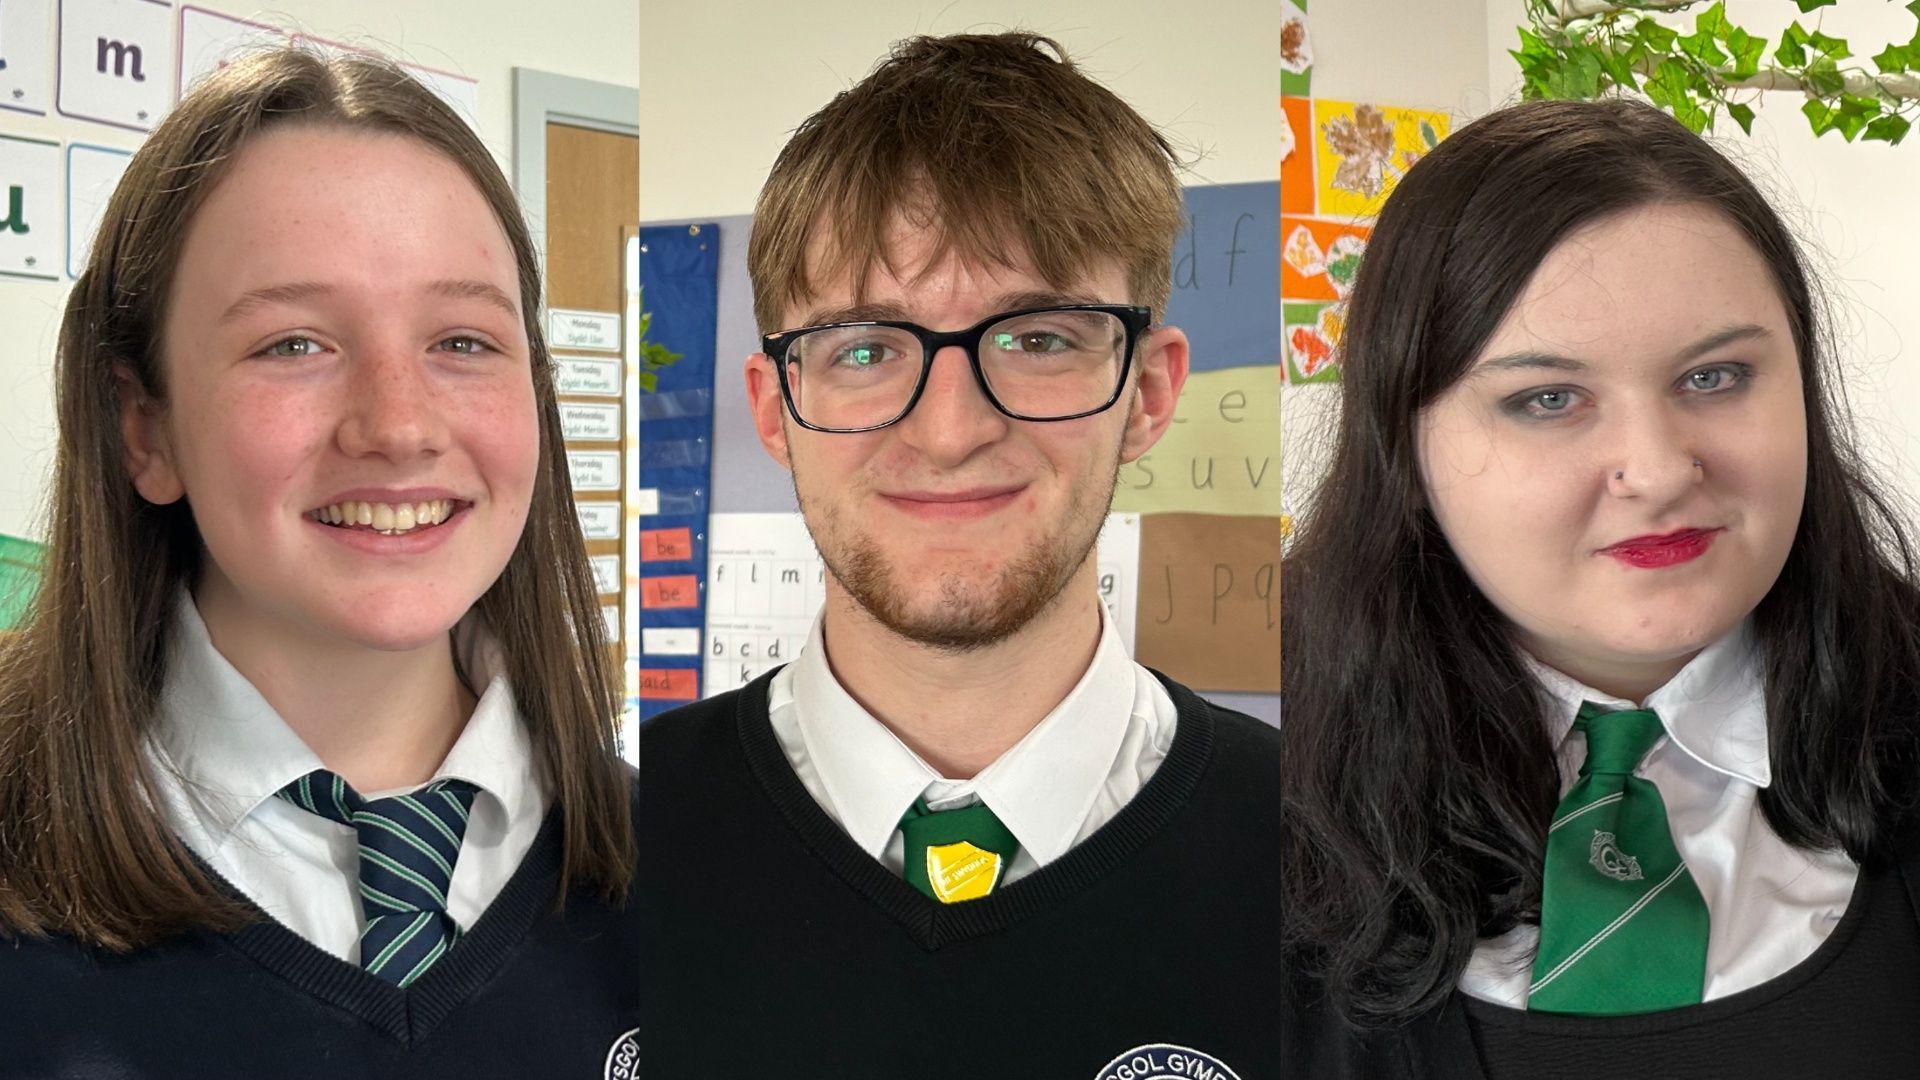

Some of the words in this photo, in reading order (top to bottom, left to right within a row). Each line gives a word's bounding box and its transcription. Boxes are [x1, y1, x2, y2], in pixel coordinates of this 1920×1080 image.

[97, 36, 145, 81] m
[1174, 213, 1200, 290] d
[1226, 212, 1255, 287] f
[572, 318, 602, 332] Monday
[572, 364, 602, 376] Tuesday
[566, 410, 606, 422] Wednesday
[1218, 390, 1246, 424] e
[1133, 456, 1154, 490] s
[1191, 456, 1214, 490] u
[1245, 456, 1269, 489] v
[656, 533, 676, 556] be
[716, 564, 724, 583] f
[781, 568, 799, 583] m
[658, 581, 681, 602] be
[1212, 563, 1234, 626] p
[1254, 563, 1276, 631] q
[713, 636, 723, 656] b
[740, 643, 750, 657] c
[768, 638, 780, 658] d
[740, 663, 750, 683] k
